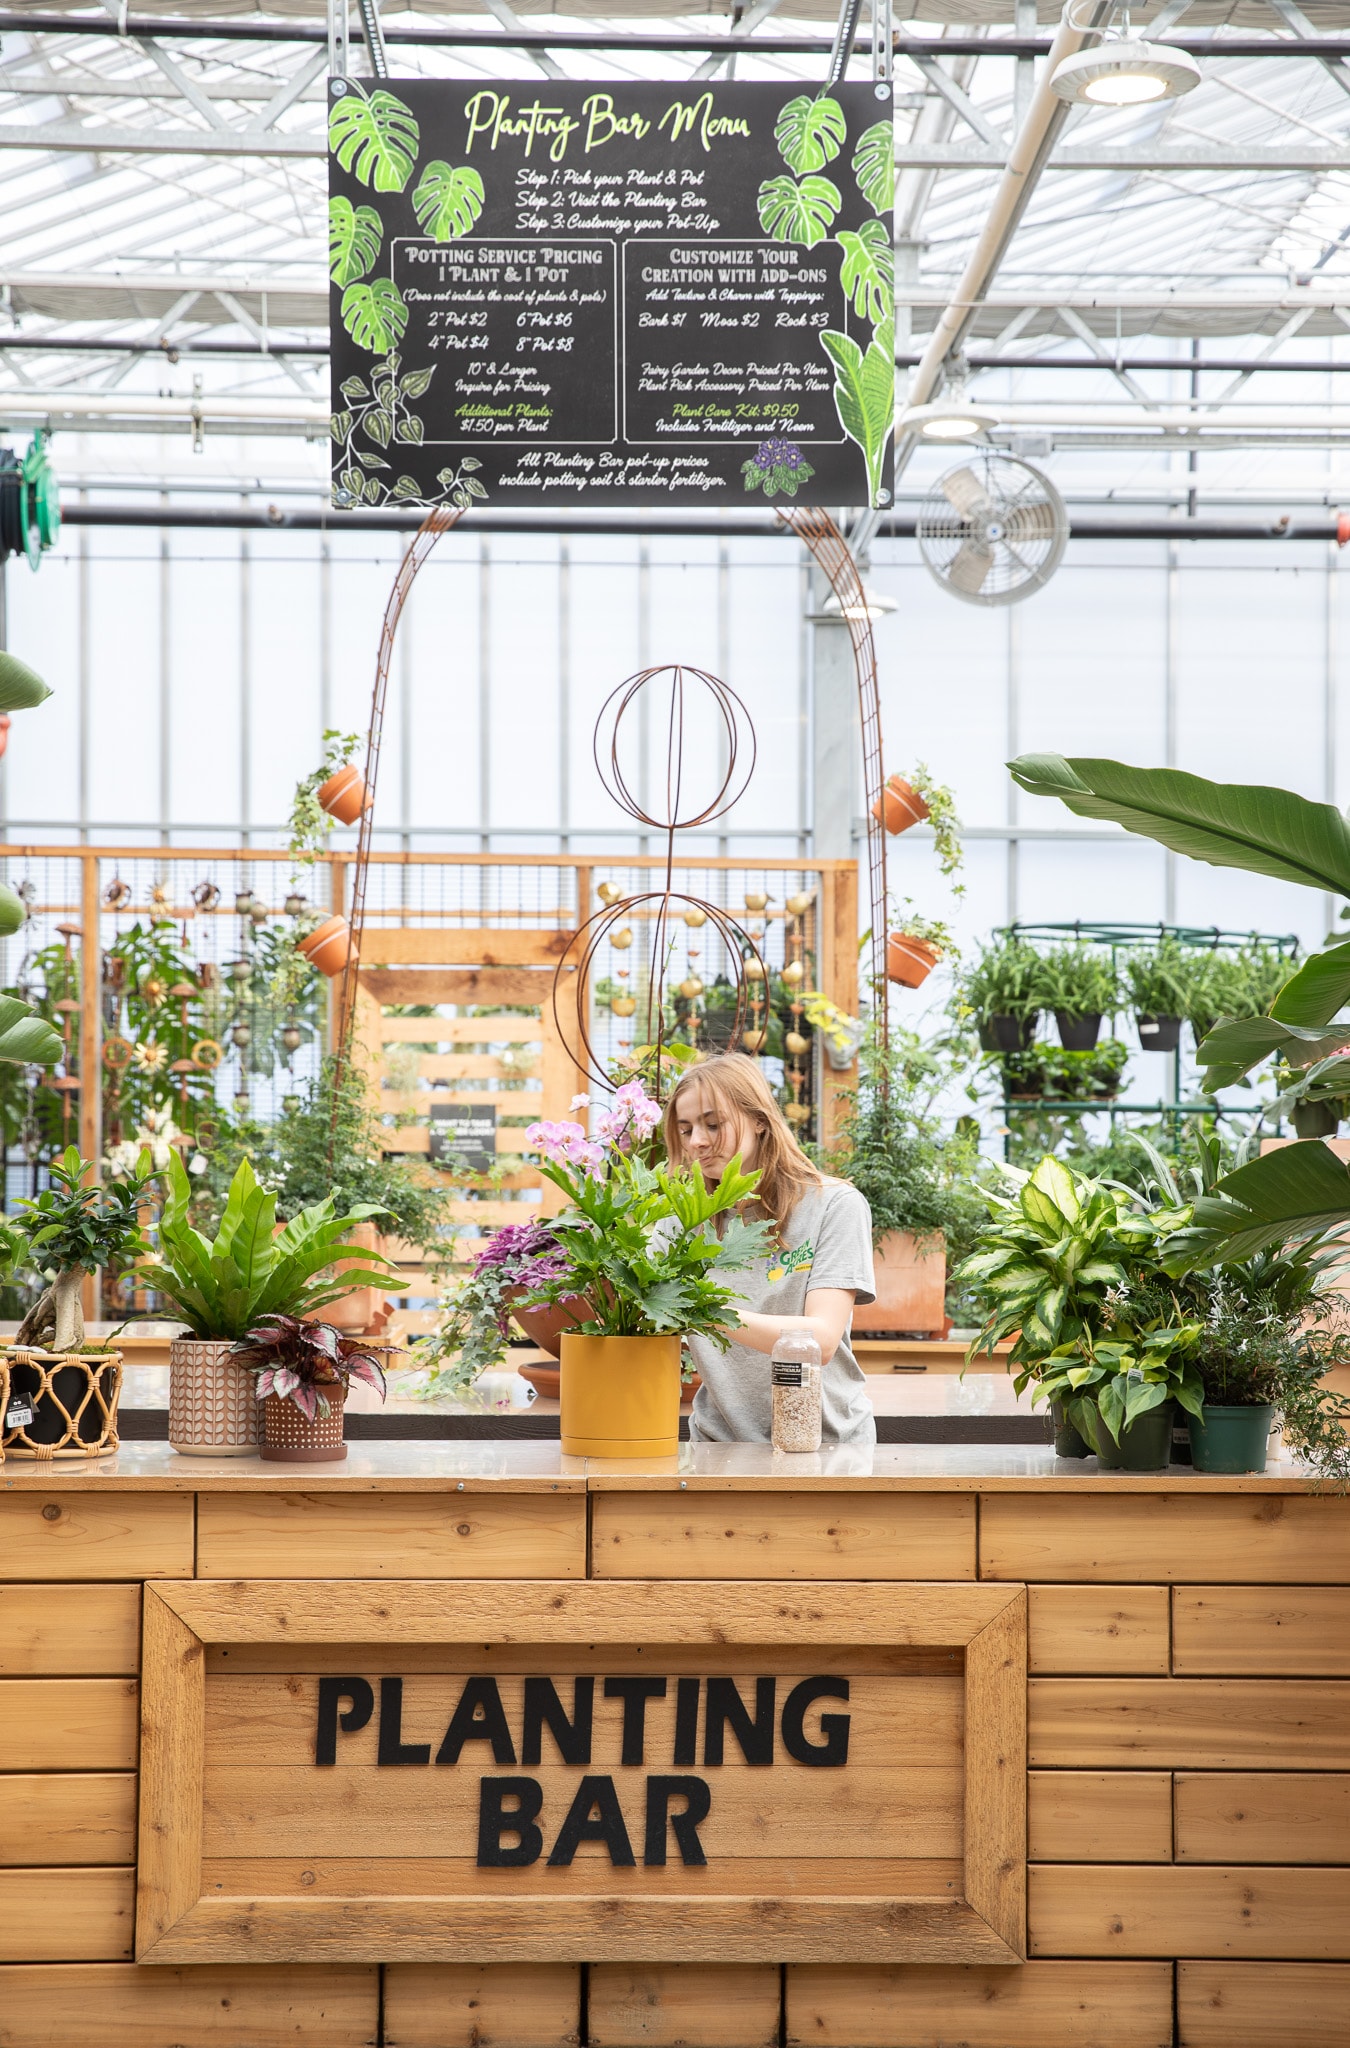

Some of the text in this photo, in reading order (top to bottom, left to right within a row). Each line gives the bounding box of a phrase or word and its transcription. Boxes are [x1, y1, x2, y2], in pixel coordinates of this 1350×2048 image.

[464, 91, 751, 162] Planting Bar Menu
[515, 169, 704, 191] Step 1: Pick your Plant & Pot
[515, 191, 707, 213] Step 2: Visit the Planting Bar
[515, 213, 720, 234] Step 3: Customize your Pot-Up
[402, 289, 607, 305] (Does not include the cost of plants & pots)
[645, 288, 825, 305] Add Texture & Charm with Toppings:
[638, 313, 687, 328] Bark $1
[700, 313, 760, 328] Moss $2
[775, 313, 829, 328] Rock $3
[641, 362, 828, 378] Fairy Garden Decor Priced Per Item
[455, 379, 551, 396] Inquire for Pricing
[638, 378, 830, 396] Plant Pick Accessory Priced Per Item
[455, 404, 554, 417] Additional Plants:
[672, 404, 799, 417] Plant Care Kit: $9.50
[460, 418, 549, 436] $1.50 per Plant
[656, 419, 815, 435] Includes Fertilizer and Neem
[517, 452, 709, 474] All Planting Bar pot-up prices
[499, 472, 727, 491] include potting soil & starter fertilizer.
[314, 1676, 851, 1768] PLANTING
[476, 1775, 711, 1868] BAR
